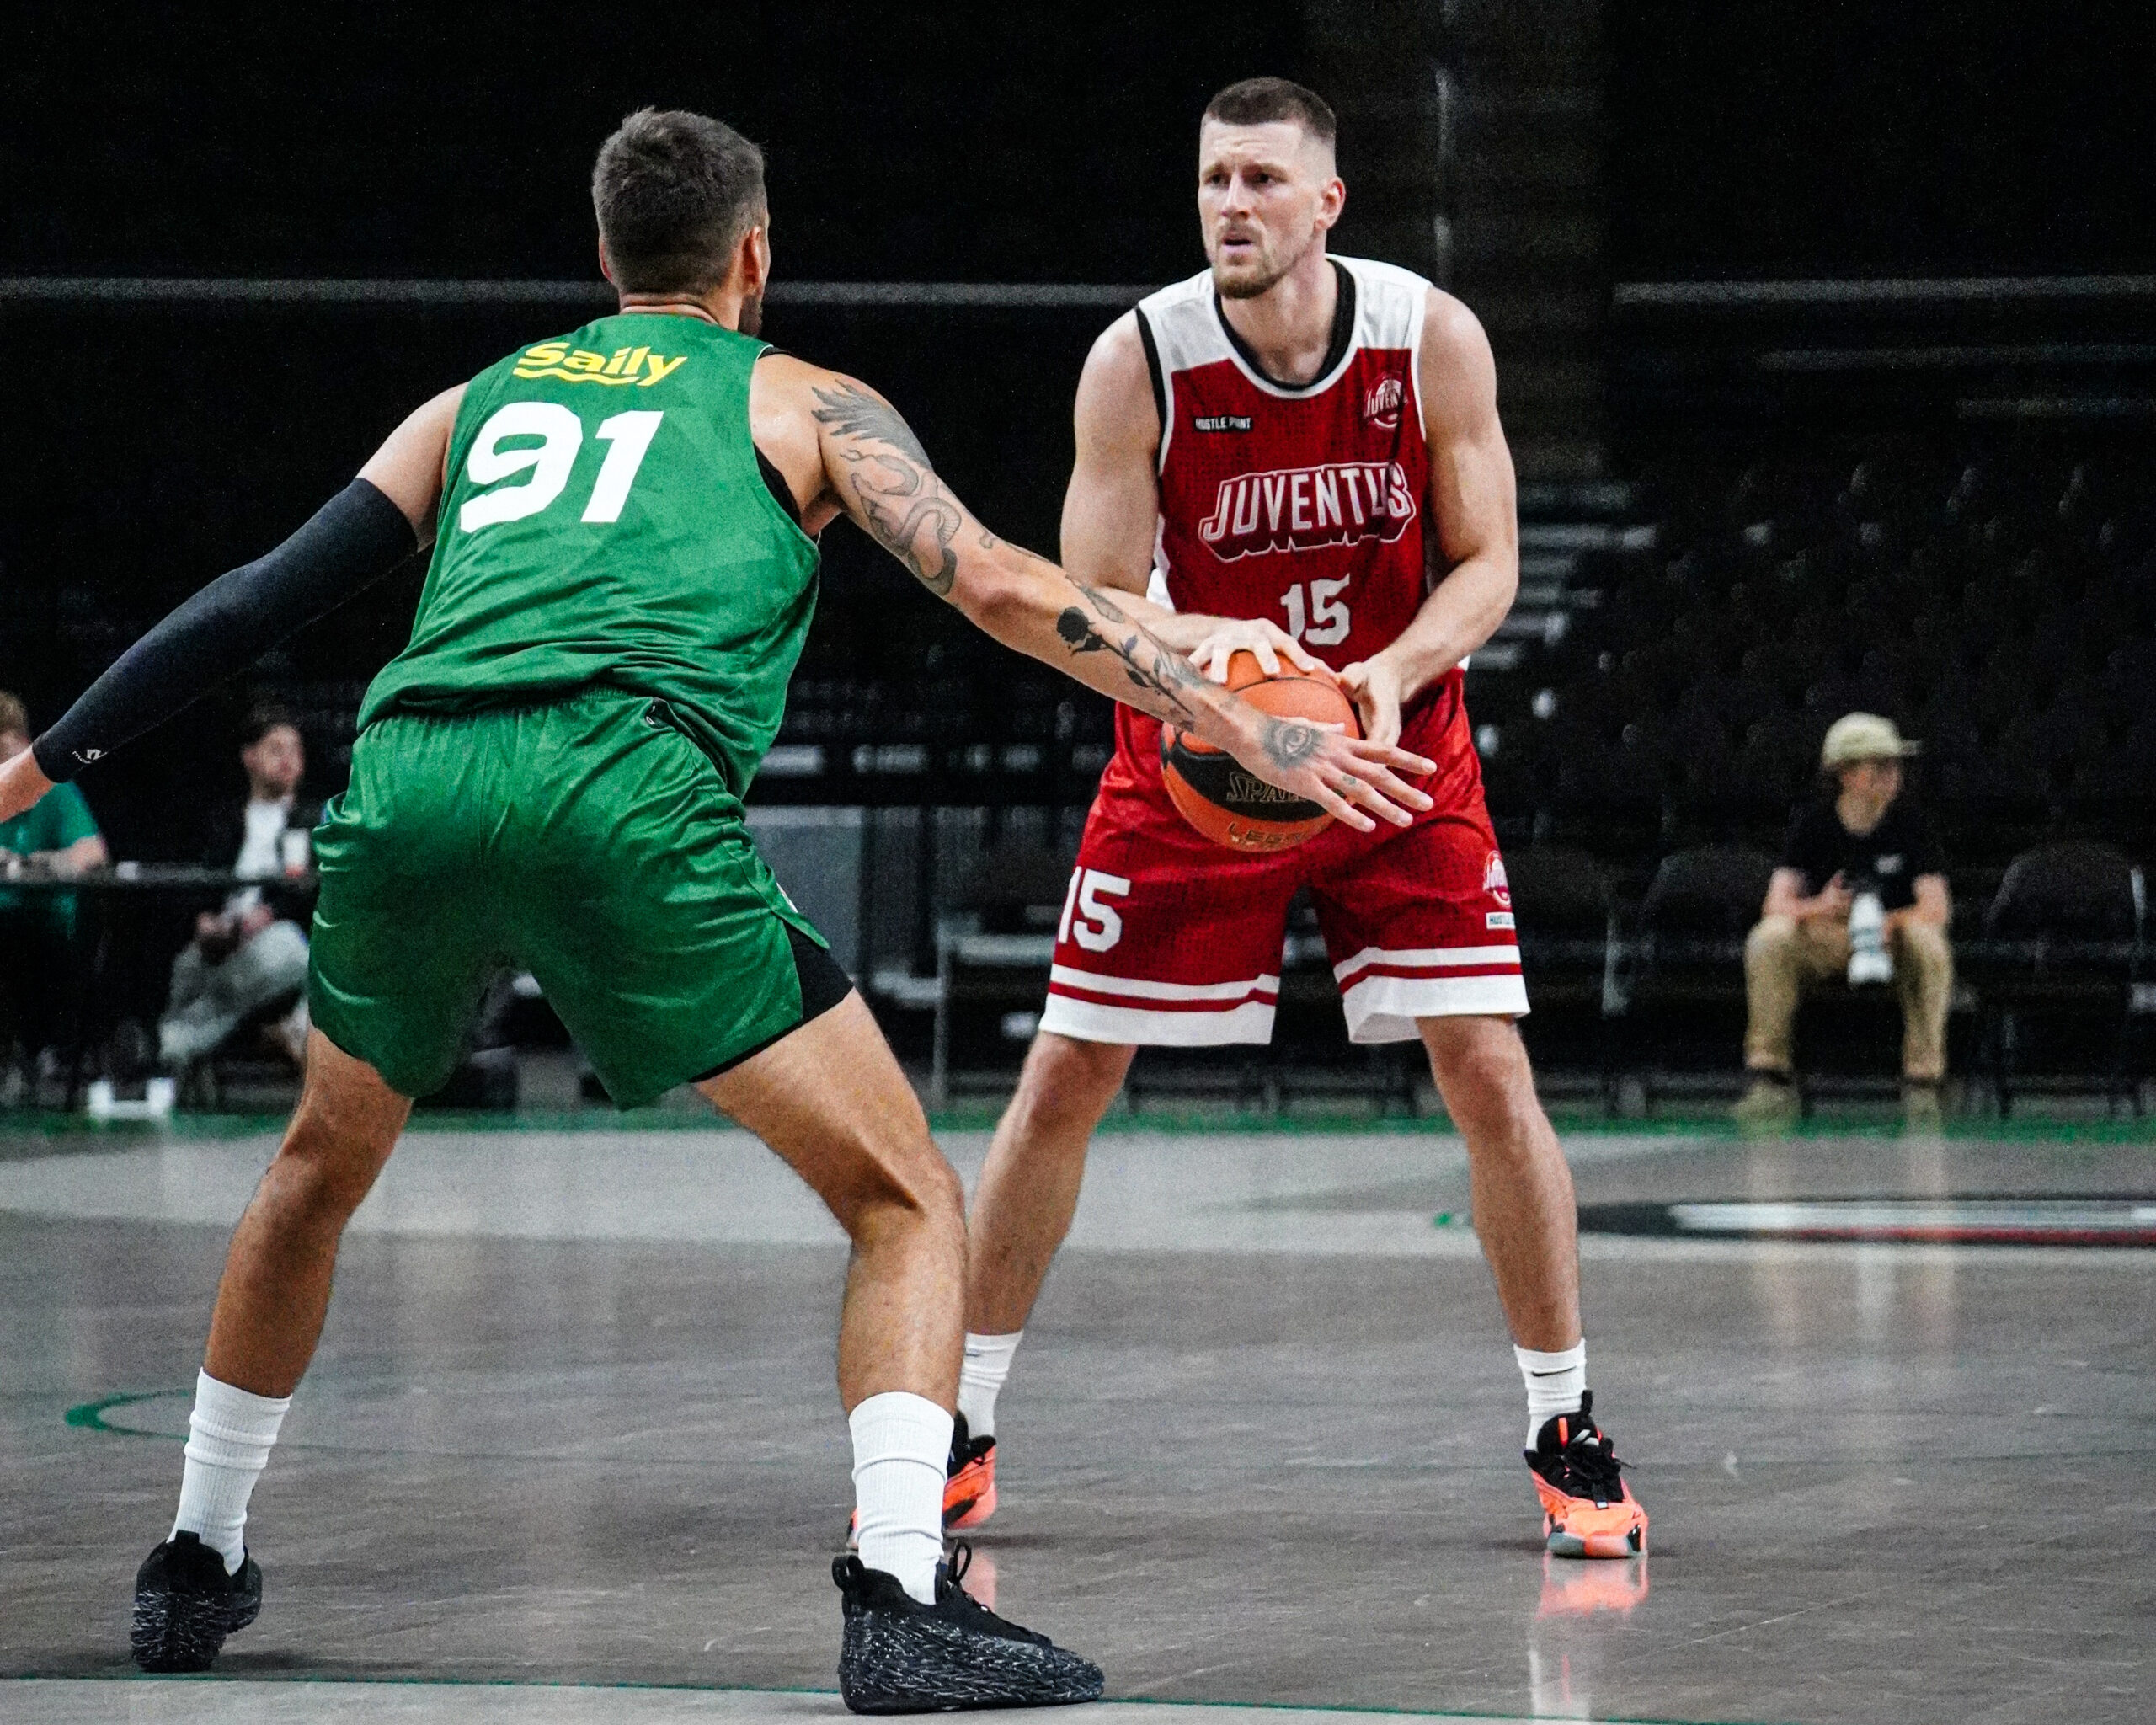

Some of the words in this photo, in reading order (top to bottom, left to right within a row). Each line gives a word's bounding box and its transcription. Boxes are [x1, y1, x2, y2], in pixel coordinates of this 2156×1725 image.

[513, 342, 688, 387] Saily
[460, 401, 664, 533] 91
[1202, 465, 1412, 543] JUVENTUS
[1279, 573, 1350, 646] 15
[1058, 865, 1130, 953] 15
